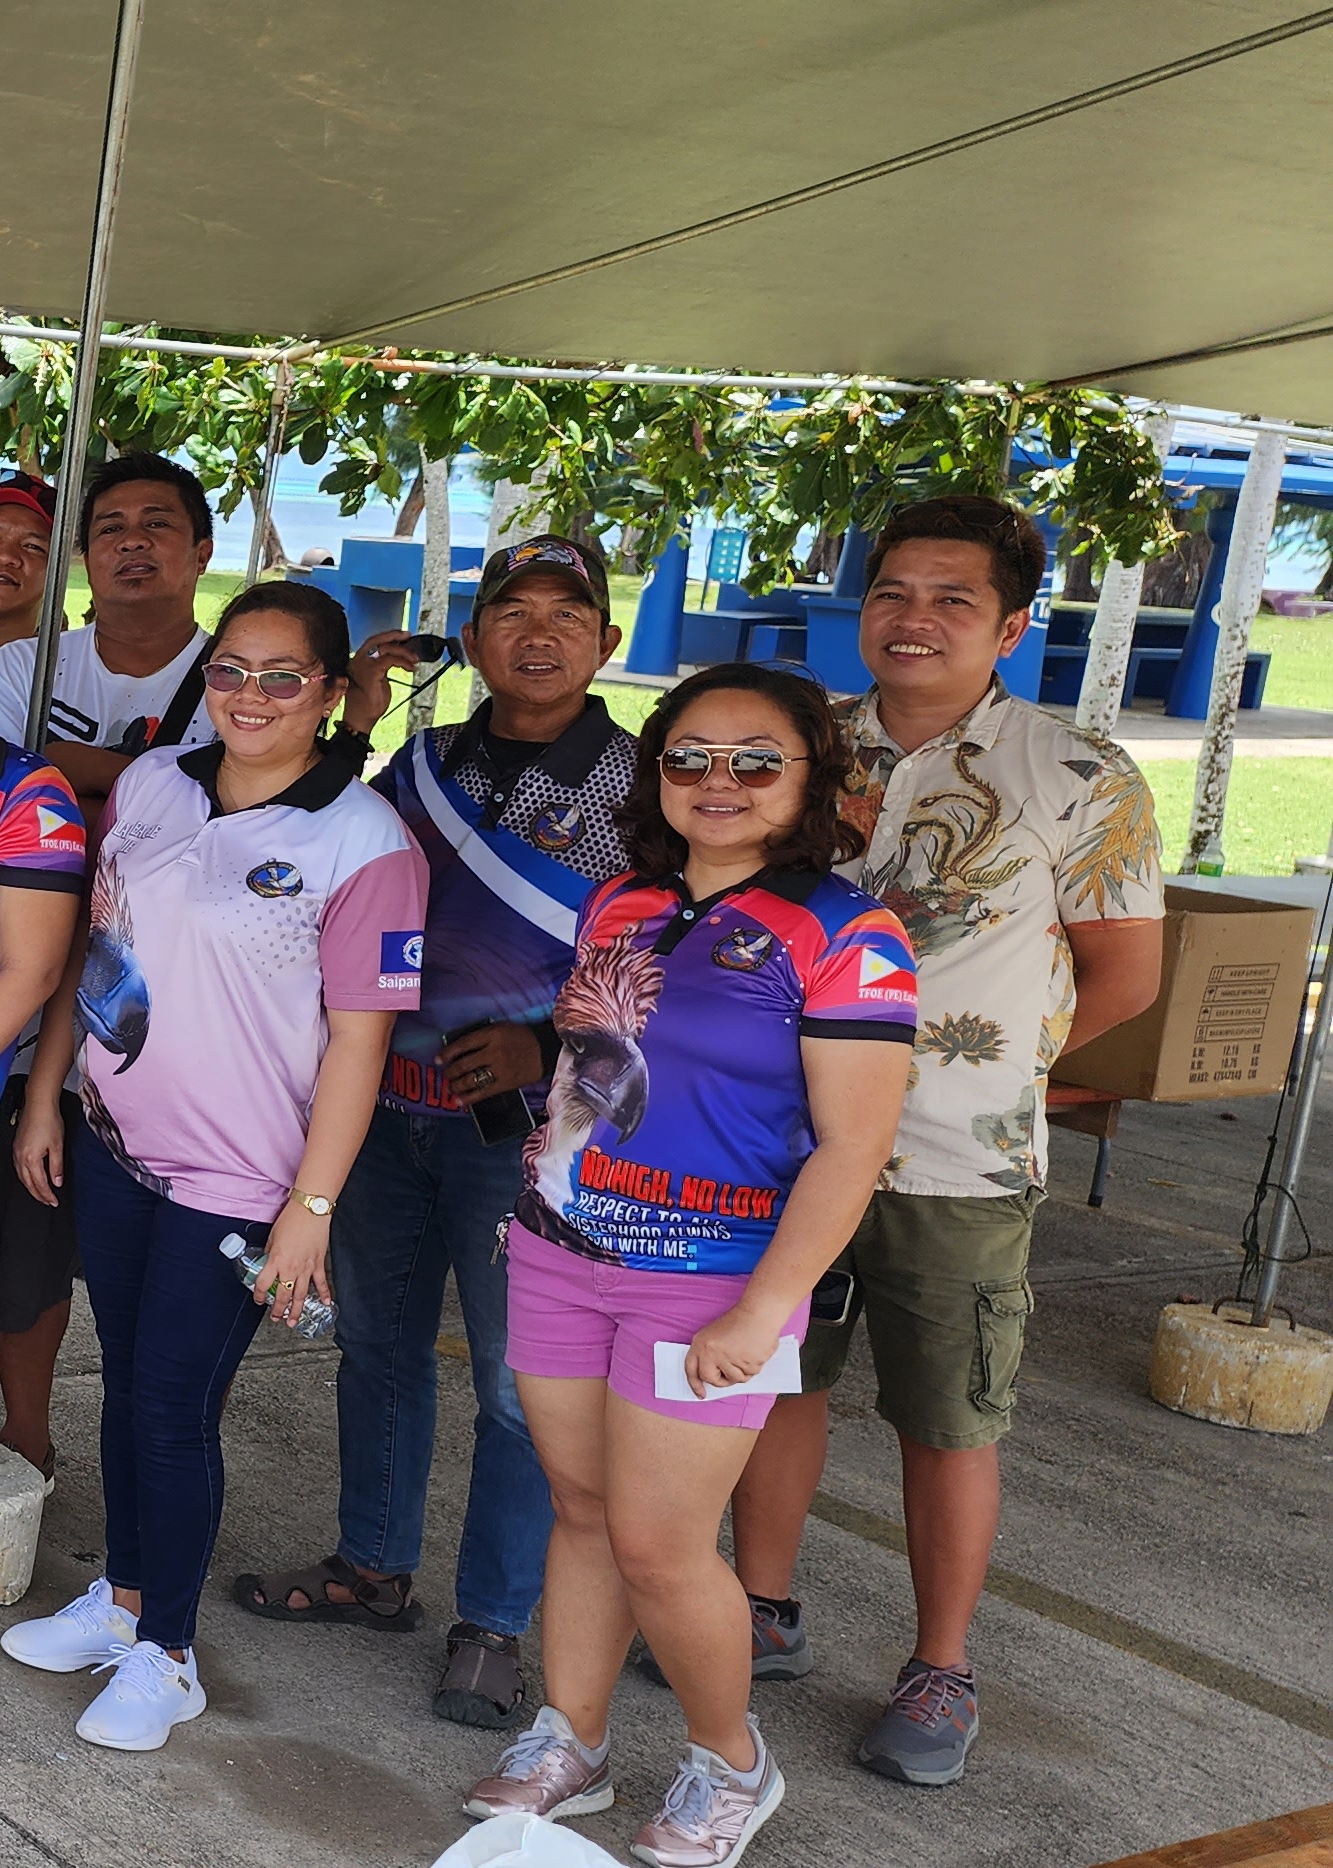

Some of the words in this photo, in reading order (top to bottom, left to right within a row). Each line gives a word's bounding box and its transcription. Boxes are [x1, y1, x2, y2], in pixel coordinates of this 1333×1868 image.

[378, 975, 421, 991] Saipan
[392, 1053, 422, 1102] NO
[579, 1150, 611, 1191] NO
[612, 1158, 675, 1209] HIGH,
[680, 1175, 717, 1213] NO
[718, 1183, 778, 1219] LOW
[574, 1190, 652, 1223] RESPECT
[618, 1237, 658, 1256] WITH
[663, 1240, 694, 1259] ME.
